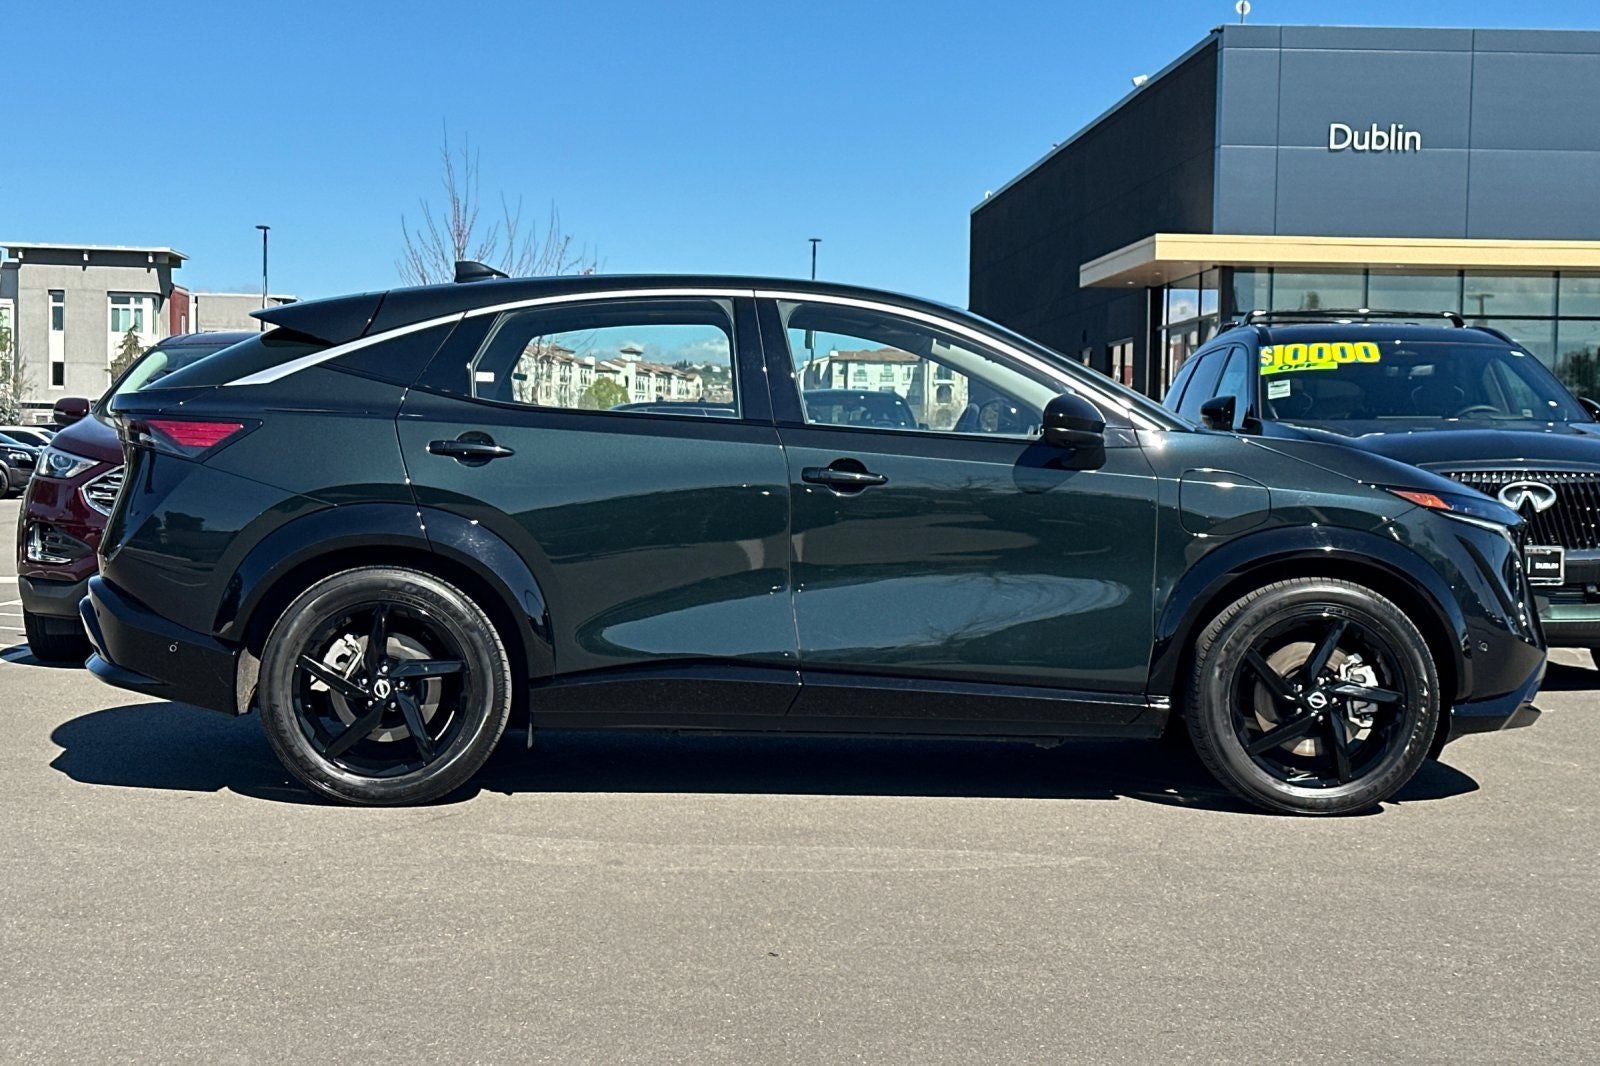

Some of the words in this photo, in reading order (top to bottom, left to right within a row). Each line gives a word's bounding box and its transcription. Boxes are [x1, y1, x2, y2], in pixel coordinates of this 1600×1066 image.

[1329, 123, 1421, 151] Dublin
[1260, 342, 1380, 366] $10000
[1278, 362, 1318, 371] OFF
